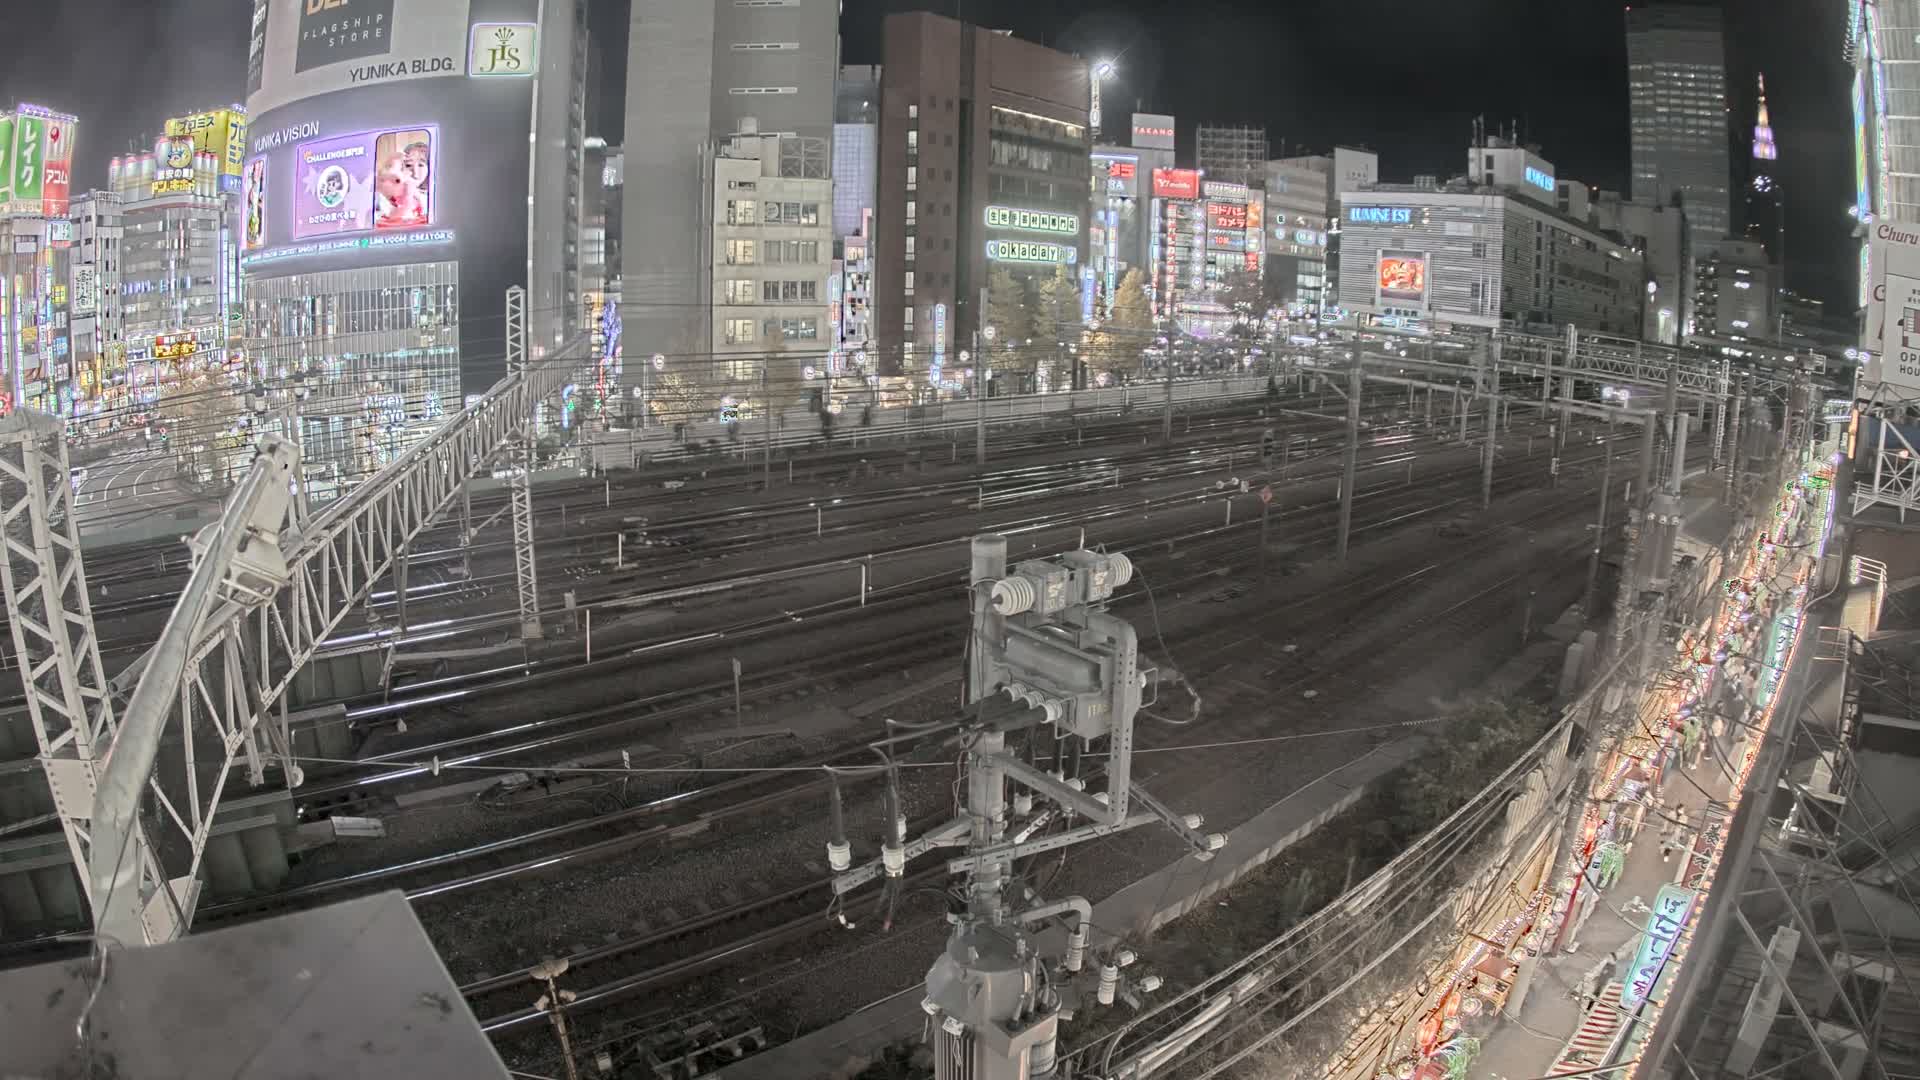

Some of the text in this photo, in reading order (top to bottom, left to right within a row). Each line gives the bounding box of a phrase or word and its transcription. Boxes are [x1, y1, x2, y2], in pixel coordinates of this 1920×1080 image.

[303, 13, 383, 40] FLAGSHIP
[329, 27, 382, 47] STORE
[350, 57, 456, 82] YUNIKA BLDG.
[254, 120, 320, 153] YUNIKA VISION
[1134, 126, 1175, 137] TAKANO
[22, 120, 37, 189] レイク
[45, 168, 68, 185] アコム
[1208, 204, 1246, 217] ヨドバシ
[1217, 217, 1246, 229] カメラ
